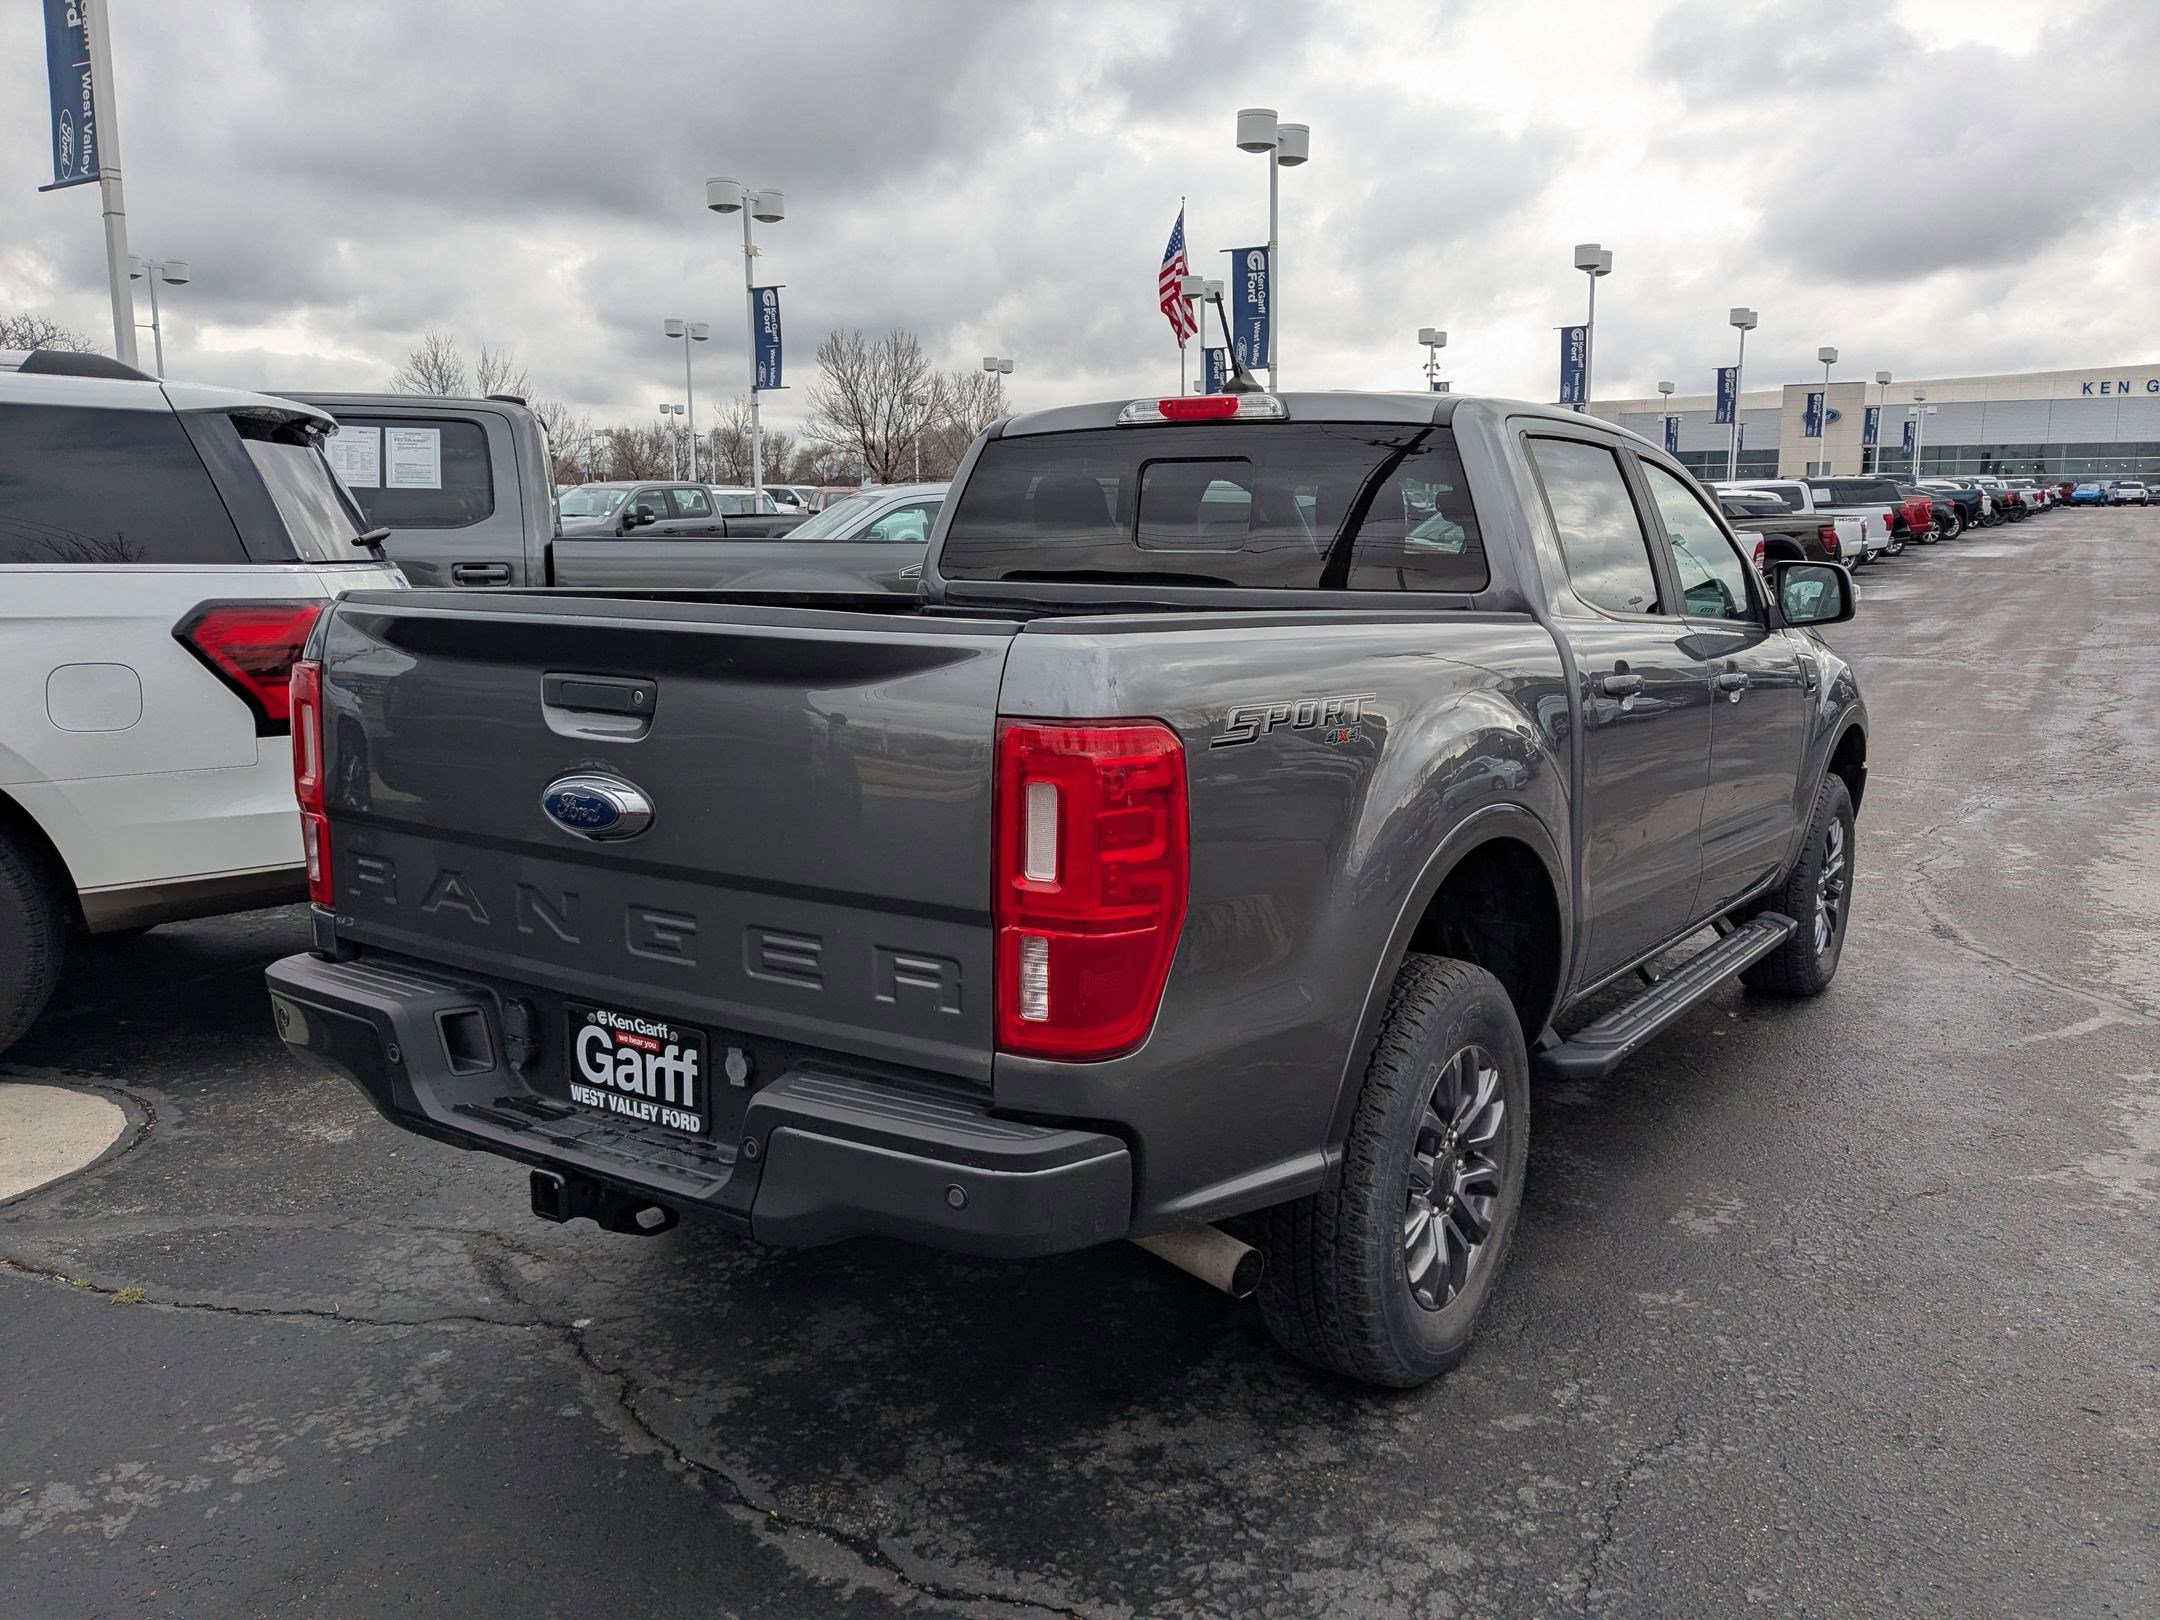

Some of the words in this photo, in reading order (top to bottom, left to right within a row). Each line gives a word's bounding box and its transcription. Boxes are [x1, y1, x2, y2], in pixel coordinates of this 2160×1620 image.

[82, 71, 93, 118] West
[81, 122, 93, 175] Valley
[1247, 272, 1257, 303] Ford
[763, 307, 772, 334] Ford
[2082, 381, 2130, 394] KEN
[1209, 692, 1376, 750] SPORT
[346, 848, 963, 1015] RANGER
[619, 1034, 628, 1043] we
[629, 1035, 643, 1046] hear
[645, 1041, 657, 1049] you
[635, 1018, 668, 1039] Garff
[576, 1025, 698, 1107] Garff
[570, 1084, 606, 1108] WEST
[608, 1095, 659, 1122] VALLEY
[662, 1109, 700, 1133] FORD
